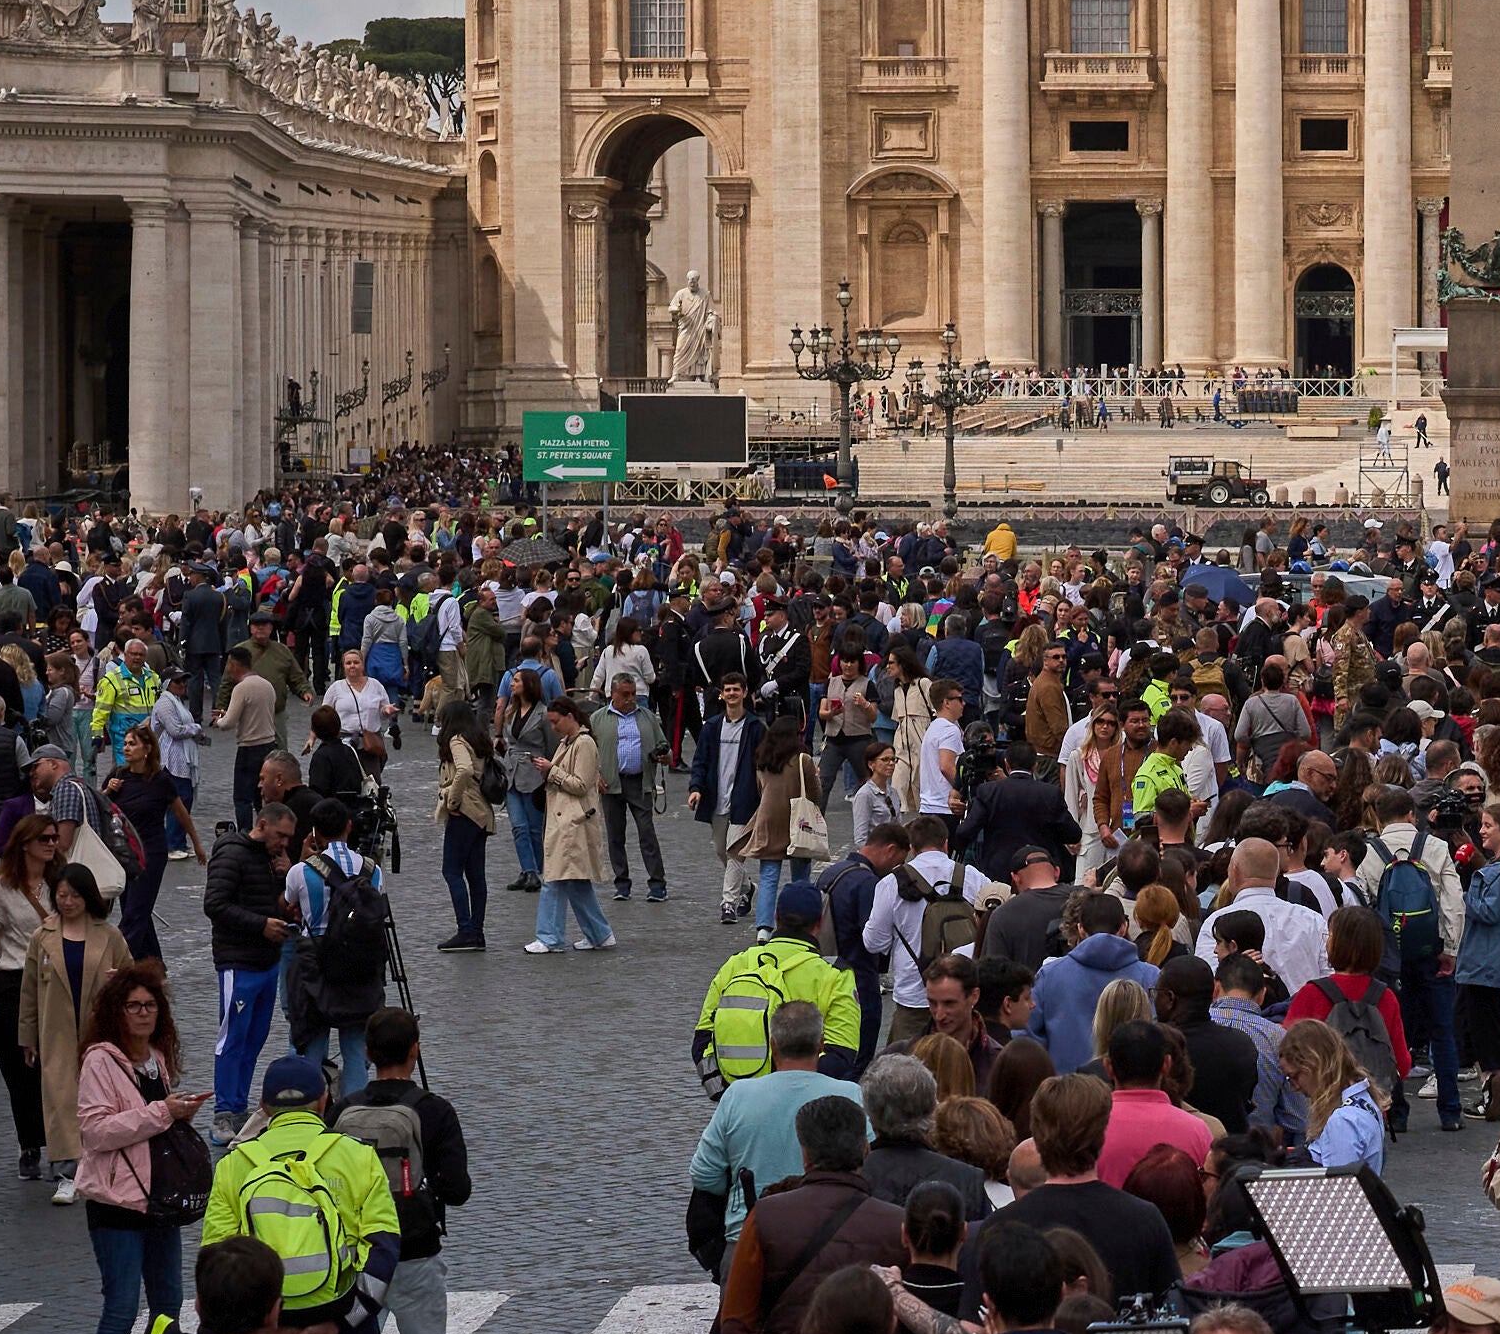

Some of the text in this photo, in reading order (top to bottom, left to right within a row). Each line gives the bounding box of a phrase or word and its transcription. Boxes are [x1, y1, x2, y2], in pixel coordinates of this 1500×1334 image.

[536, 452, 613, 460] ST. PETER'S SQUARE
